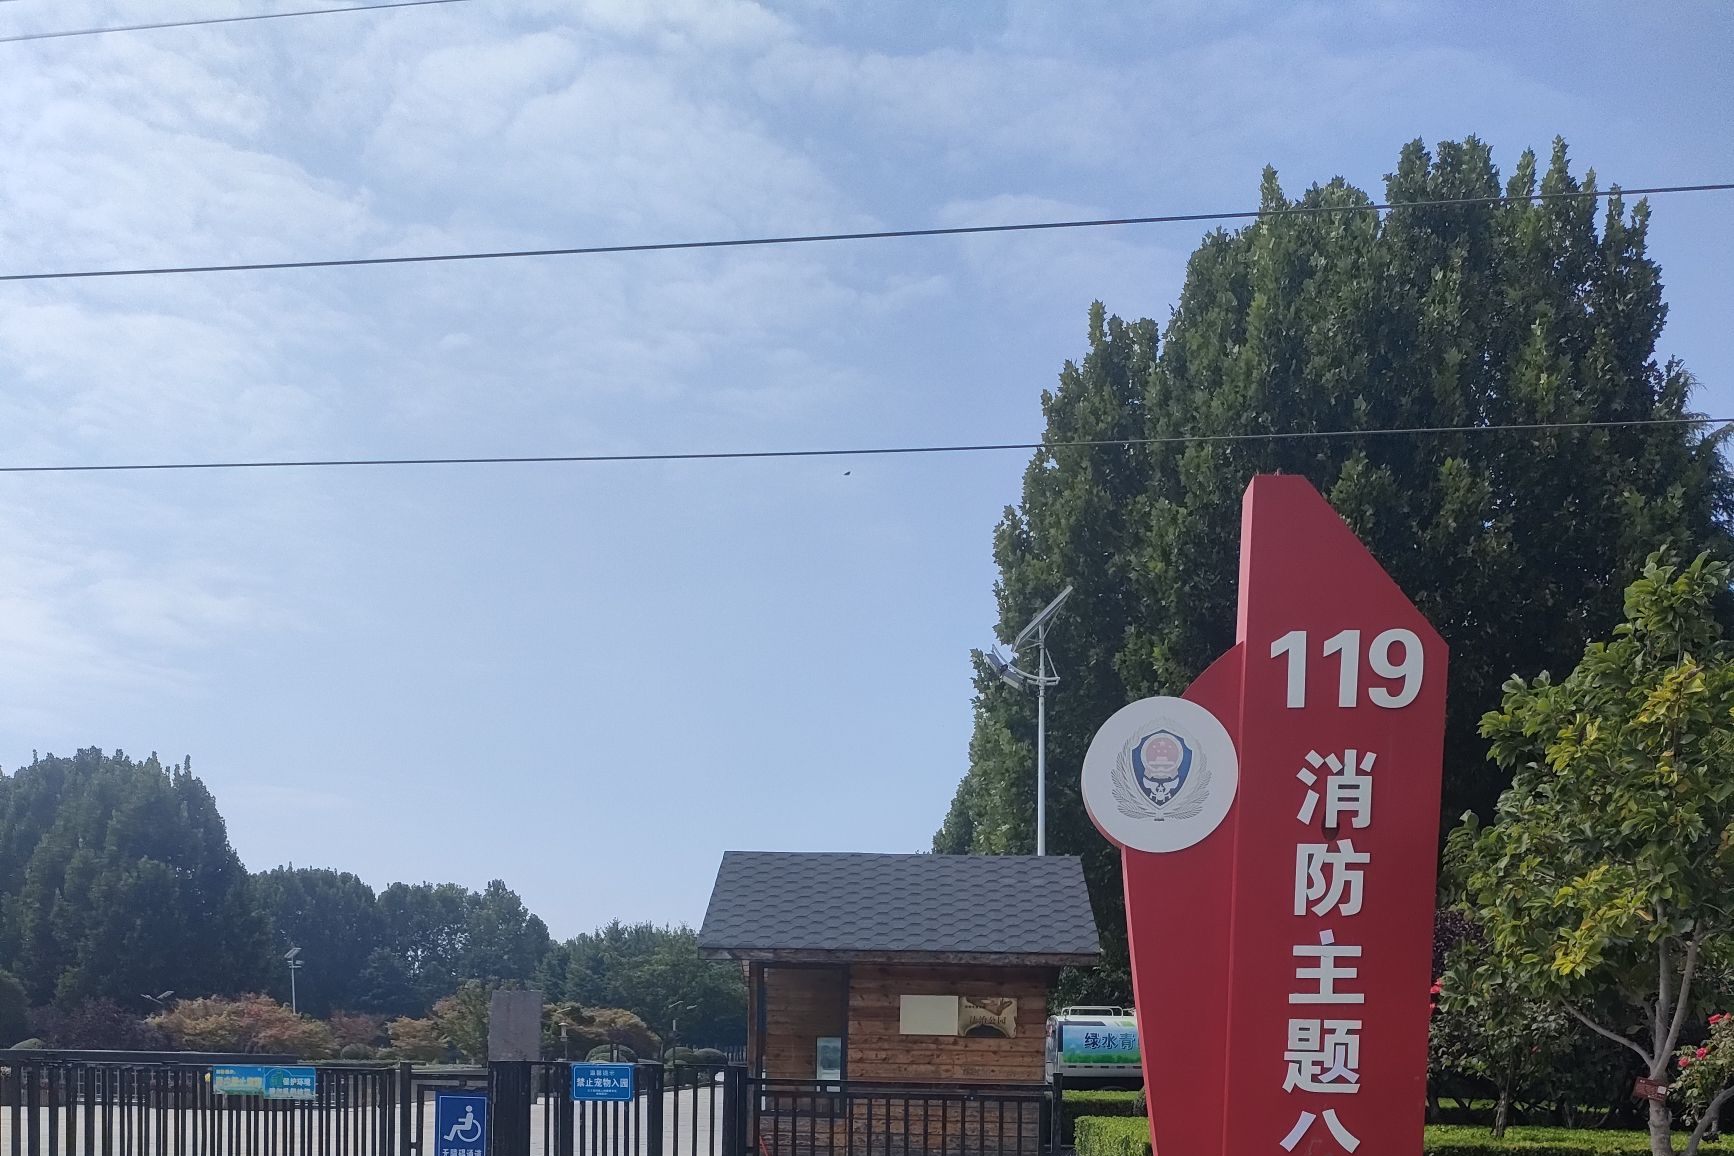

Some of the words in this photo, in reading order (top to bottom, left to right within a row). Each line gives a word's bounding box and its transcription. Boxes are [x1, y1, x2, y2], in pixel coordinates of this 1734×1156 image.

[1270, 628, 1425, 709] 119
[1084, 1032, 1139, 1050] 绿水青
[576, 1077, 629, 1088] 禁止宠物入园
